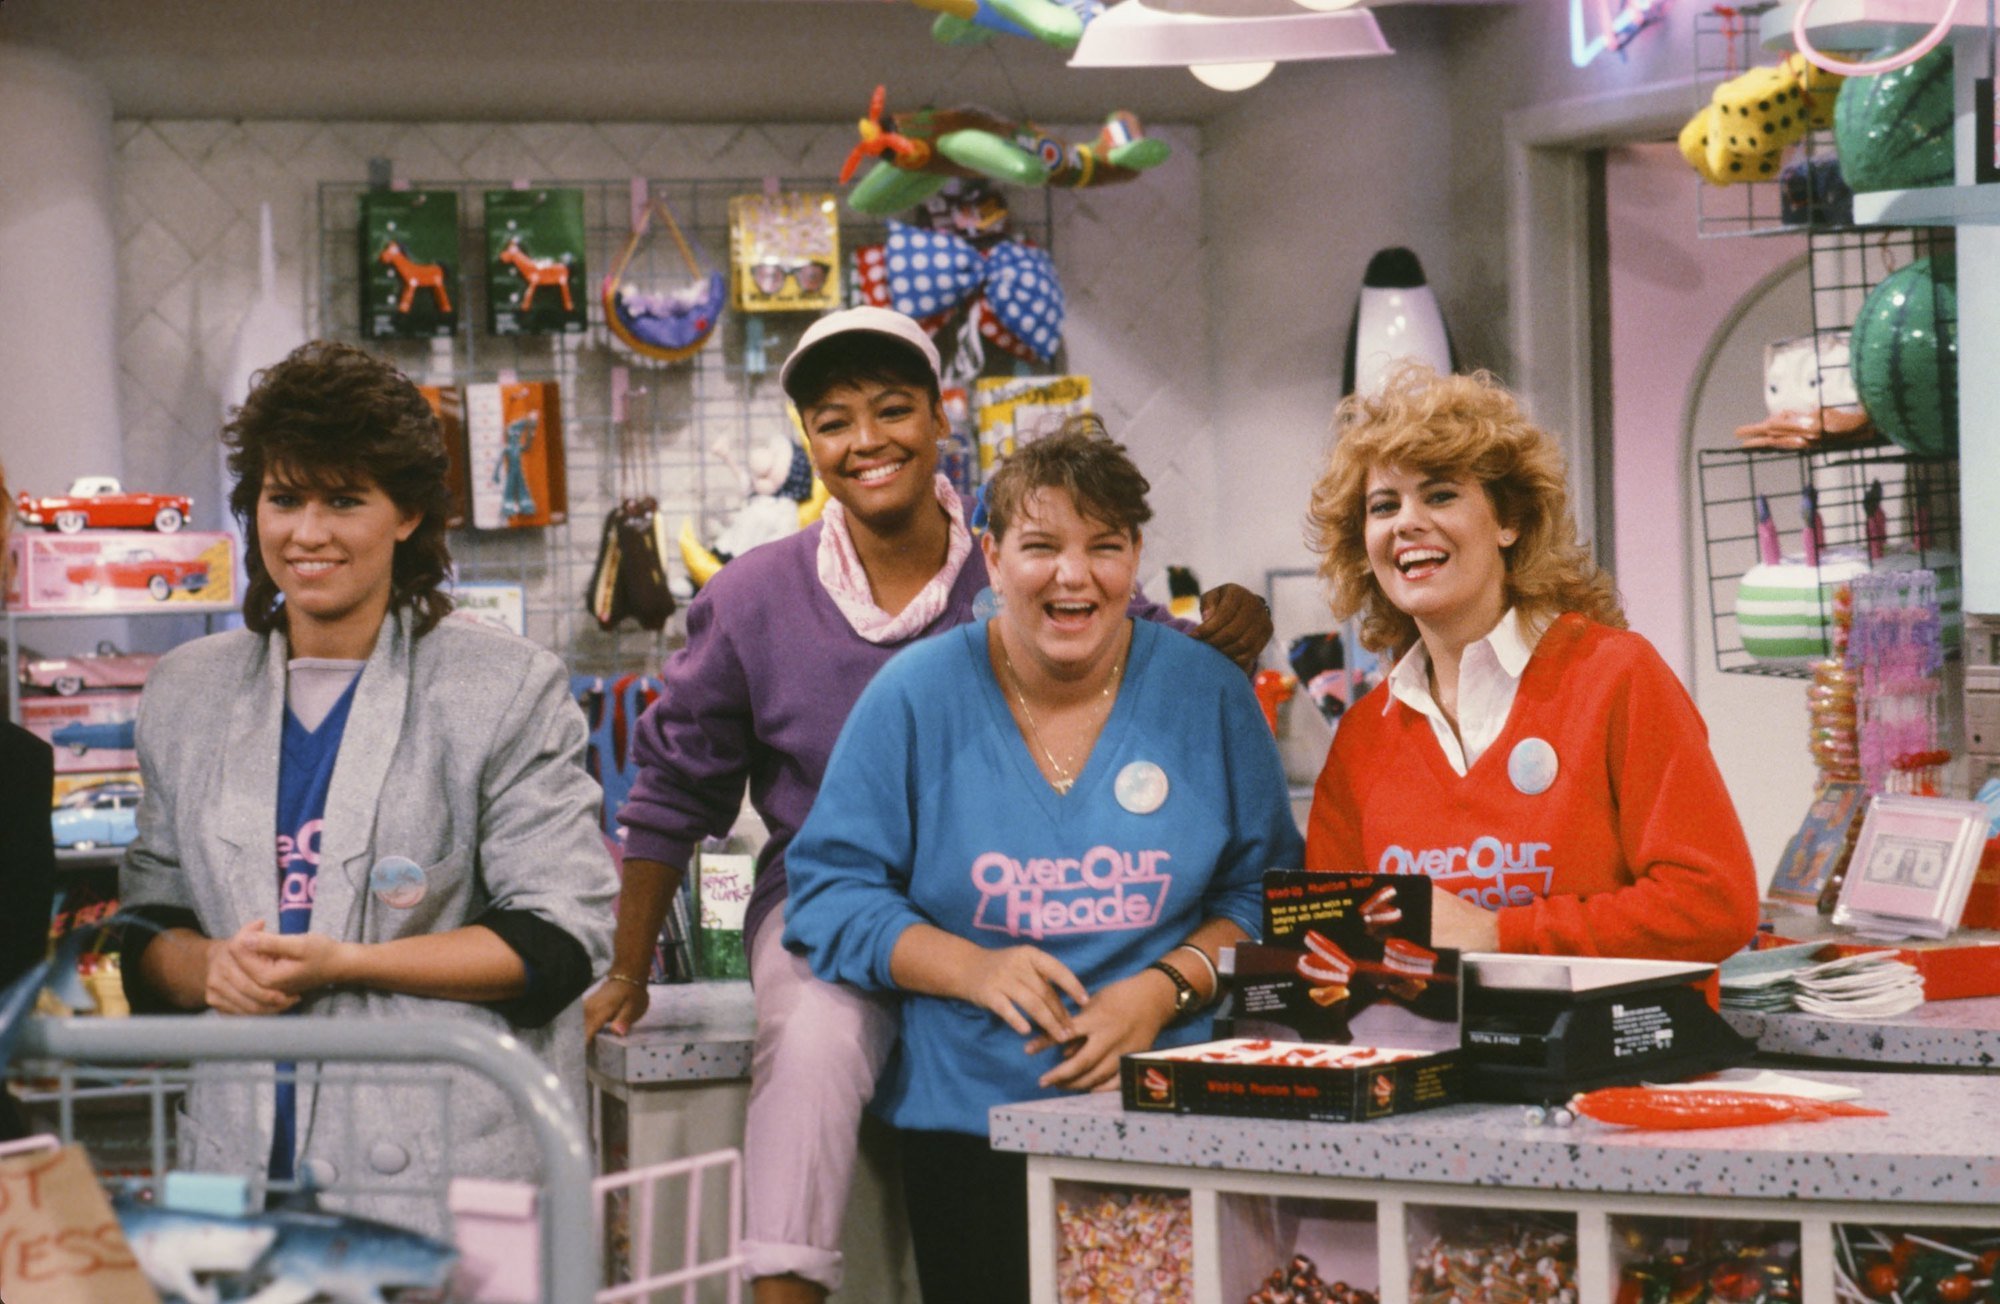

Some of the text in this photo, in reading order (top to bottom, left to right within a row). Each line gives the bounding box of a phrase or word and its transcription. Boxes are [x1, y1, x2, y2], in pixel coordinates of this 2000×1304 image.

[971, 845, 1171, 895] Over Our
[1379, 836, 1551, 879] Over Our
